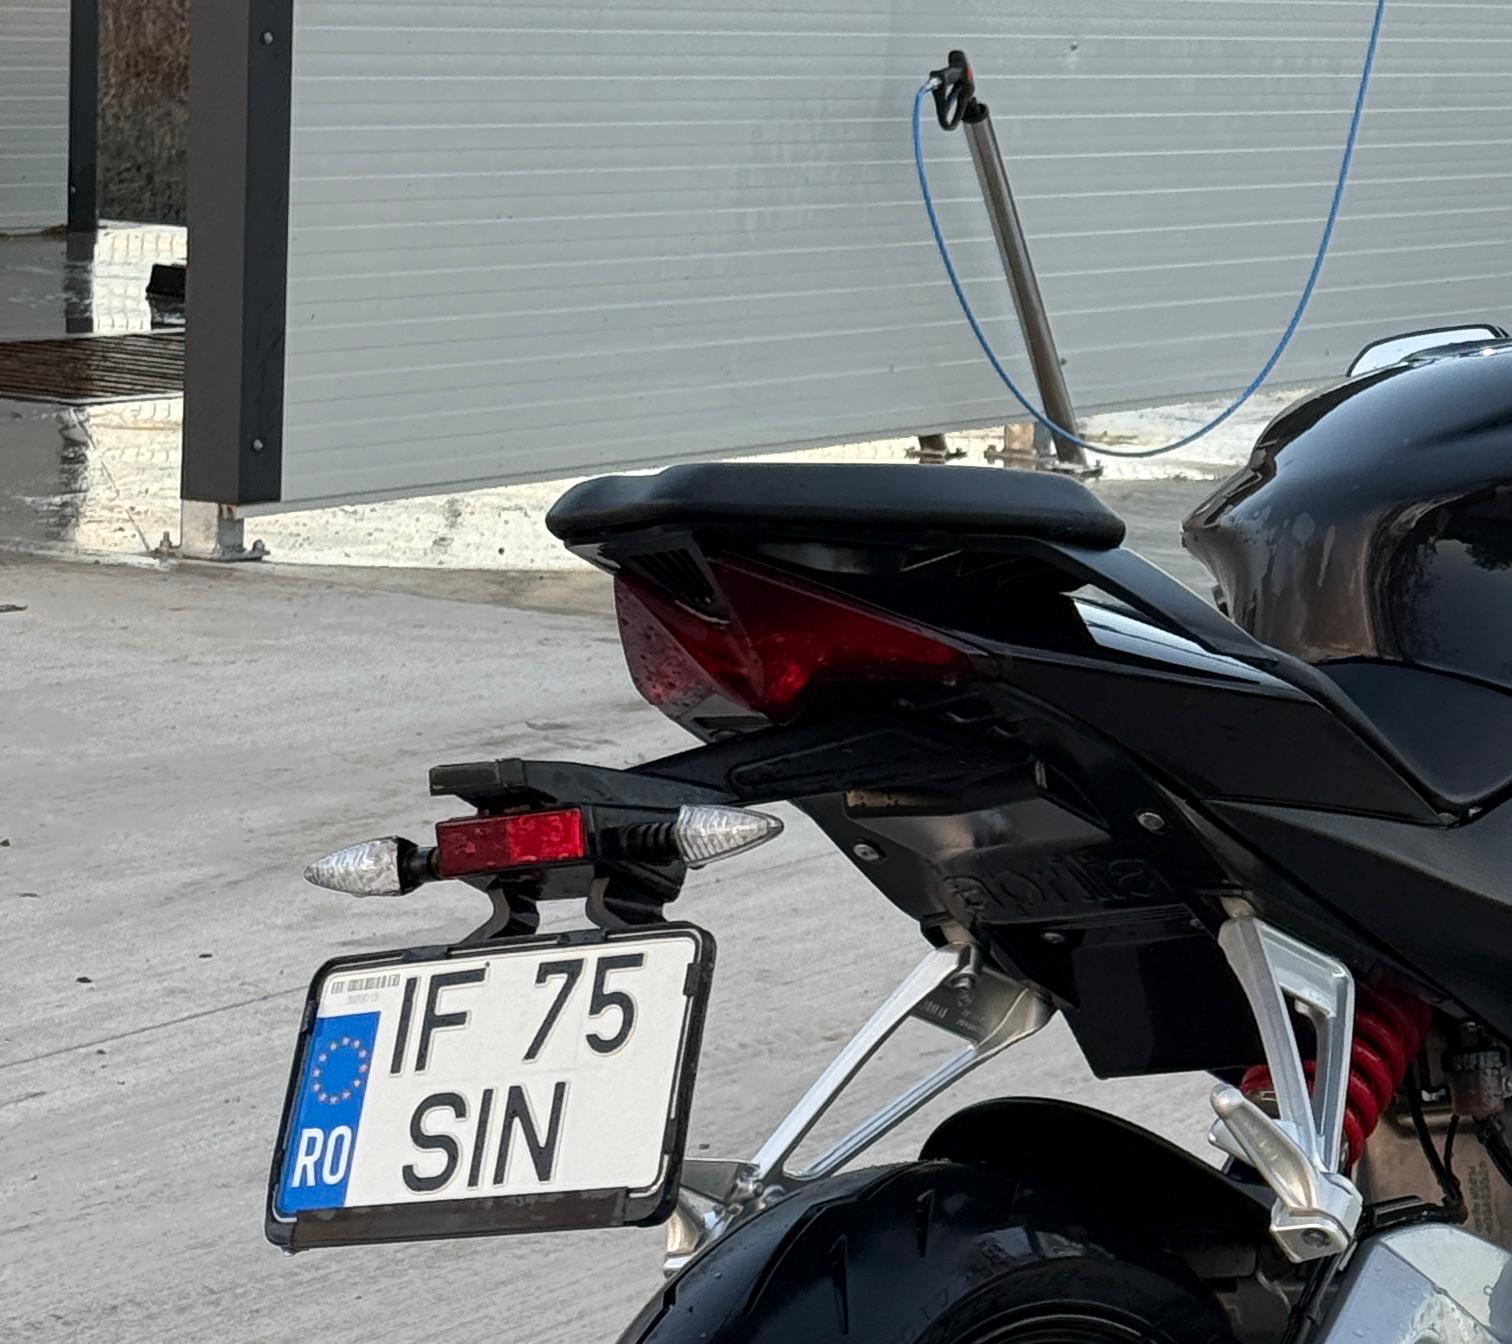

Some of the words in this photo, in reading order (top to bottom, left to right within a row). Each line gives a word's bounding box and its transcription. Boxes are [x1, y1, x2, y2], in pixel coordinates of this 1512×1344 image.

[390, 967, 486, 1076] IF
[522, 952, 645, 1062] 75
[291, 1124, 353, 1189] RO
[402, 1080, 568, 1193] SIN
